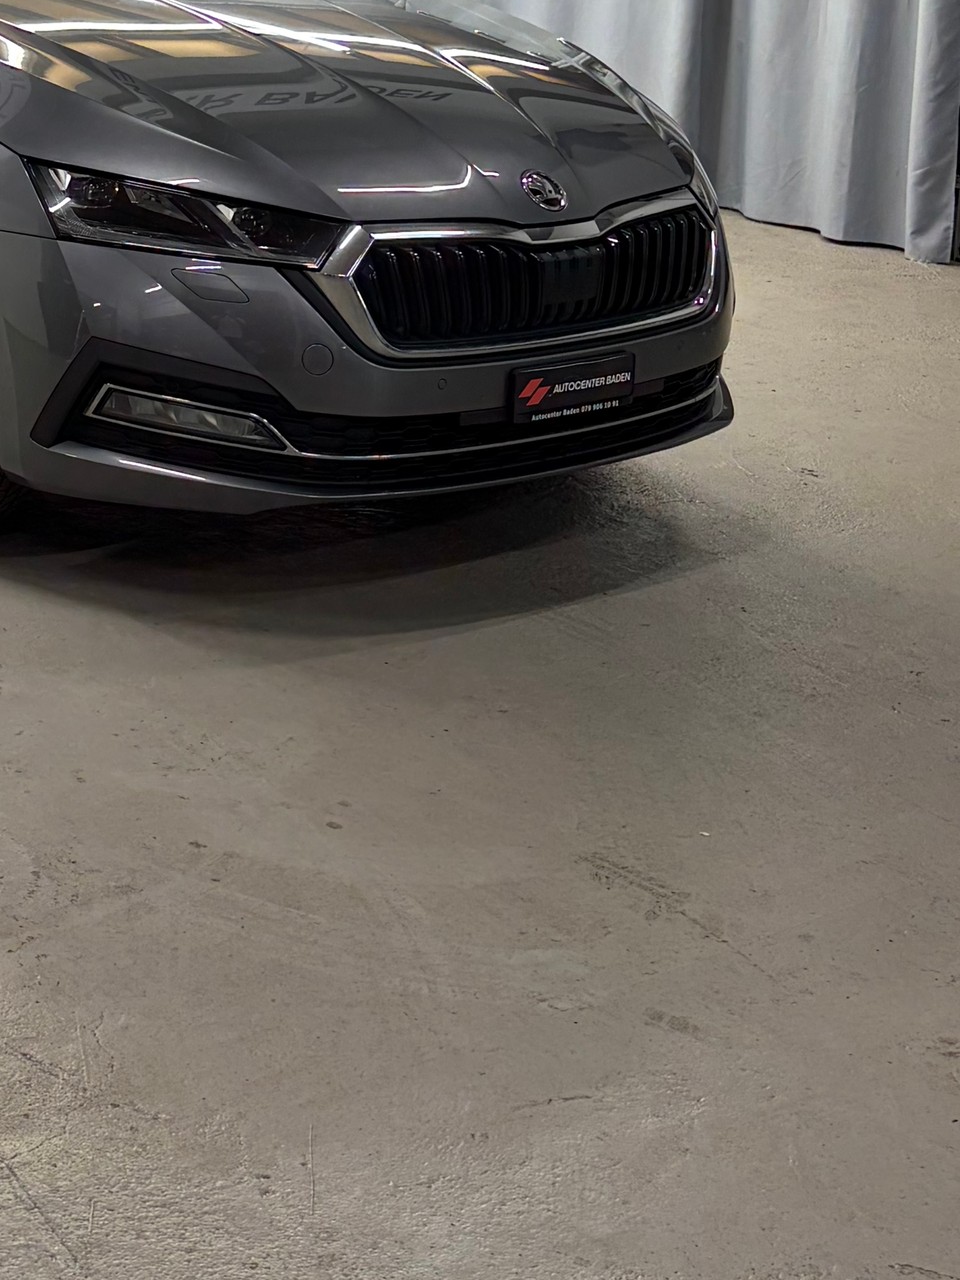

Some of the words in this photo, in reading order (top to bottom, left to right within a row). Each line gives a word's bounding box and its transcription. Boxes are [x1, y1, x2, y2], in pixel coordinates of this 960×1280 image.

[552, 377, 605, 394] AUTOCENTER
[606, 372, 631, 385] BADEN
[531, 410, 562, 422] Autocenter
[562, 407, 580, 416] Baden
